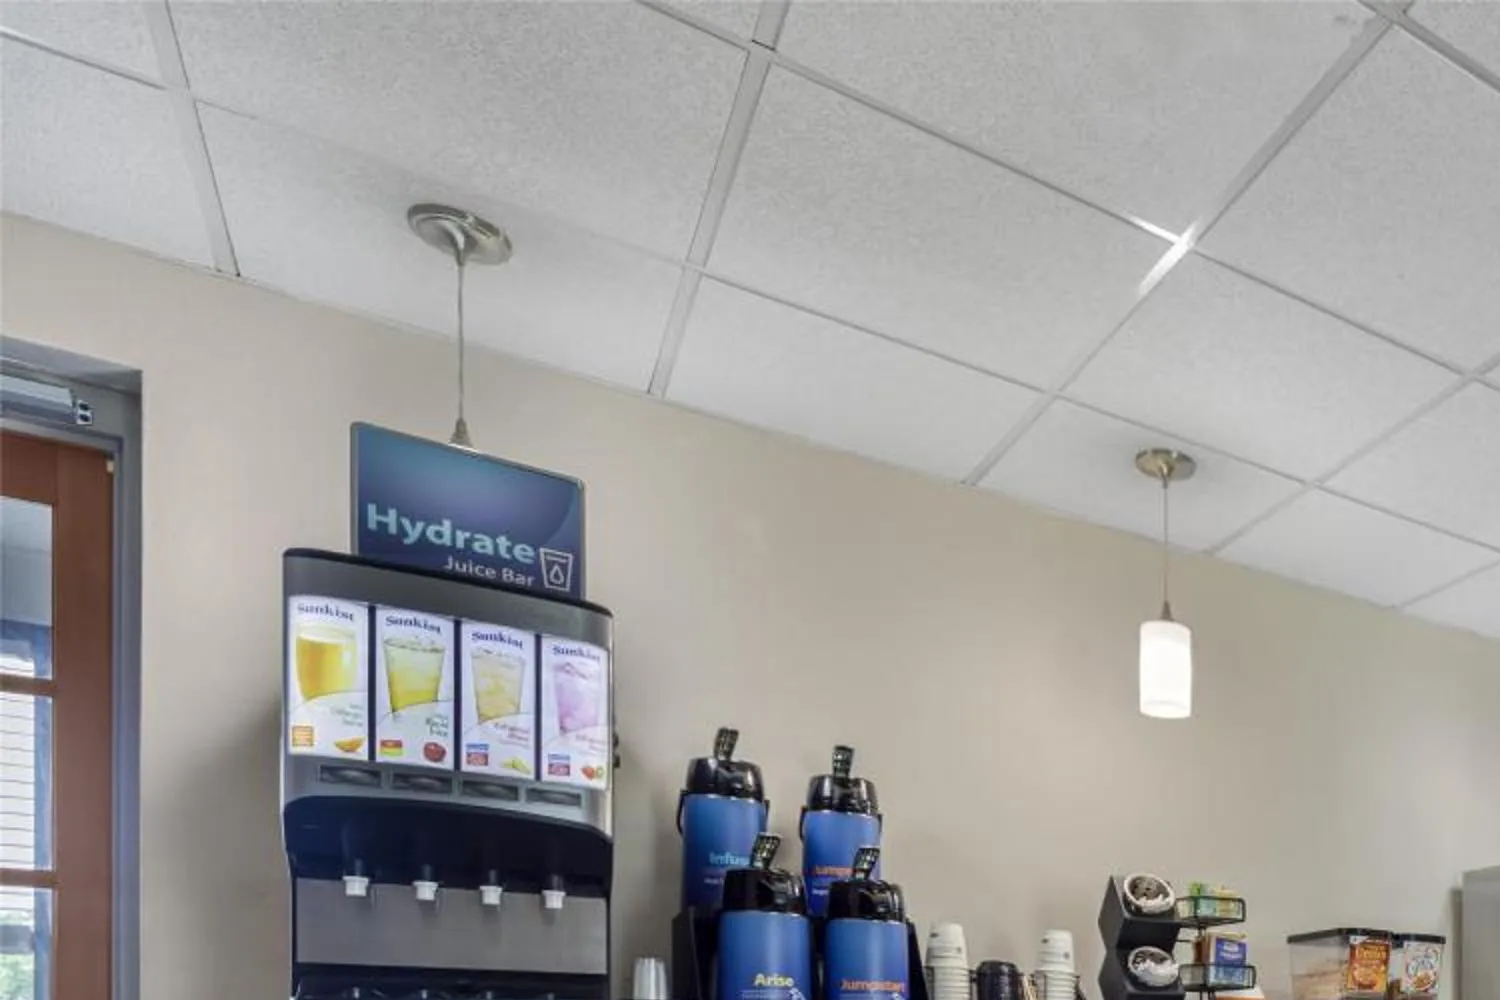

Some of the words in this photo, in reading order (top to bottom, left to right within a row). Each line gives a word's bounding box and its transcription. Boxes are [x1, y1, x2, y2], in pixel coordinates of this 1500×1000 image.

[367, 503, 536, 564] Hydrate
[444, 556, 497, 579] Juice
[501, 567, 536, 588] Bar
[297, 602, 355, 623] Sunkist
[386, 614, 442, 635] Sunkist
[471, 630, 524, 650] Sunkist
[552, 643, 600, 662] Sunkist
[753, 972, 795, 988] Arise
